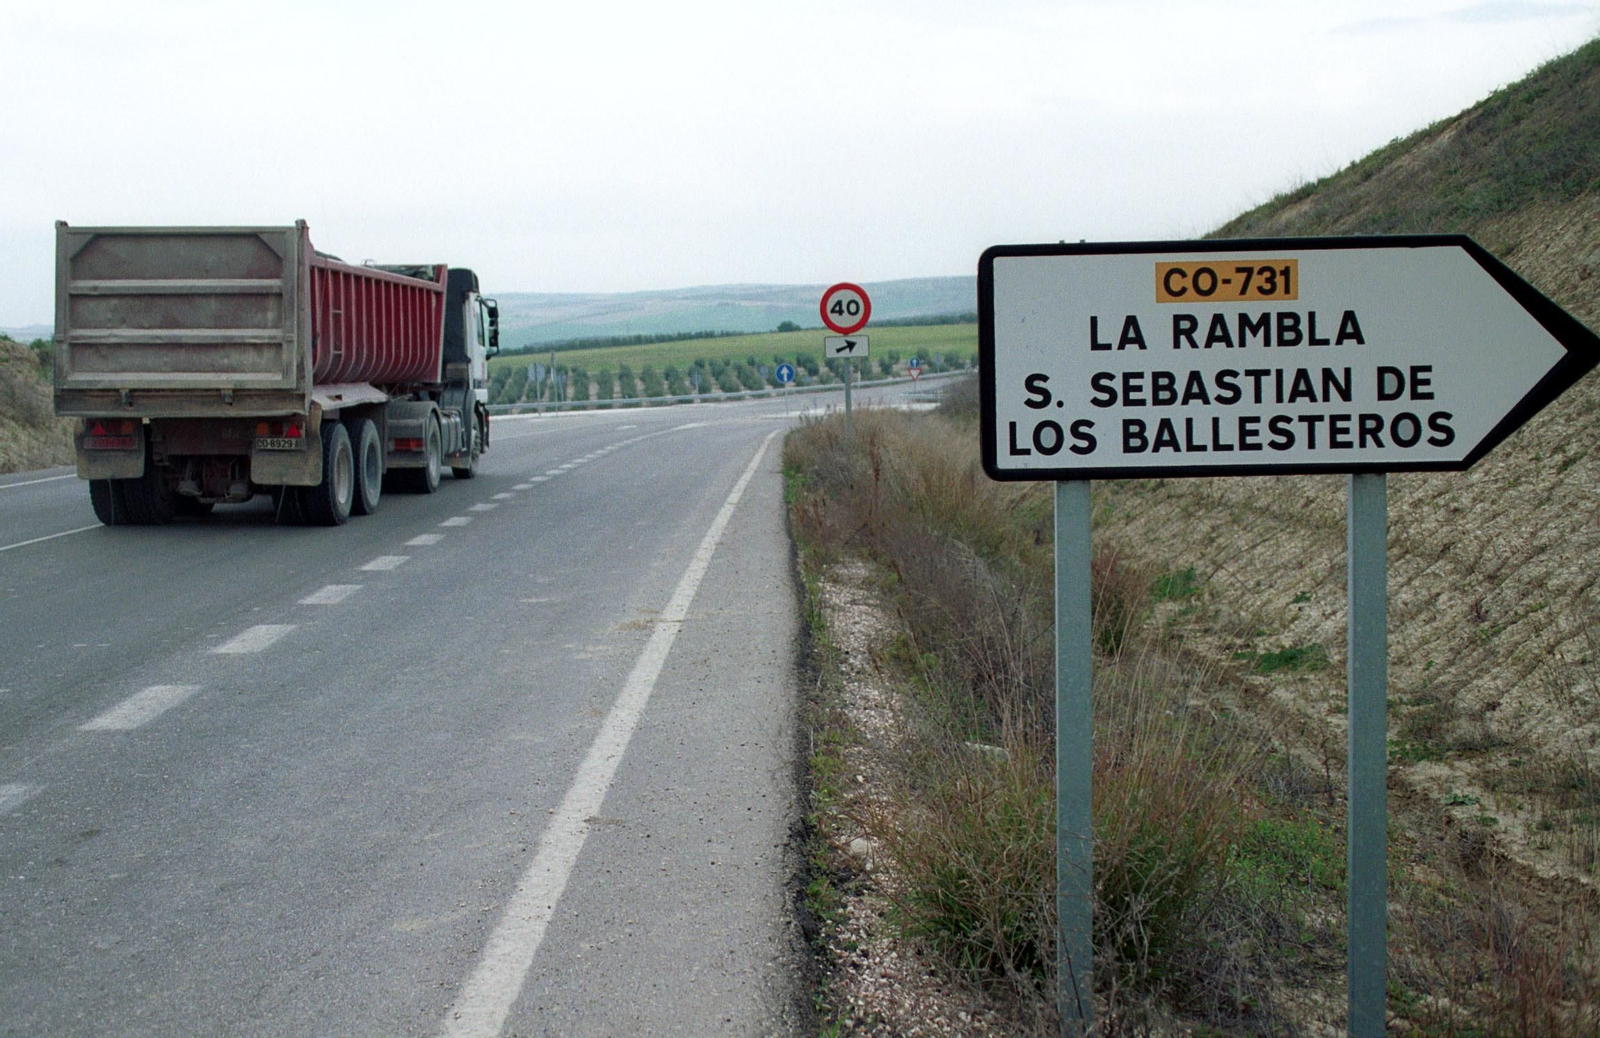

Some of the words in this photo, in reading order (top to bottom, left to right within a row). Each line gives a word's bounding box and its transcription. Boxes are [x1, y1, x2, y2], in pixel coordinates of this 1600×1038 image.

[1163, 265, 1290, 297] CO-731
[830, 299, 860, 316] 40
[1089, 315, 1147, 351] LA
[1173, 310, 1365, 349] RAMBLA
[1024, 373, 1064, 409] S.
[1090, 367, 1352, 408] SEBASTIAN
[1377, 365, 1435, 401] DE
[1009, 419, 1097, 456] LOS
[1122, 411, 1456, 453] BALLESTEROS
